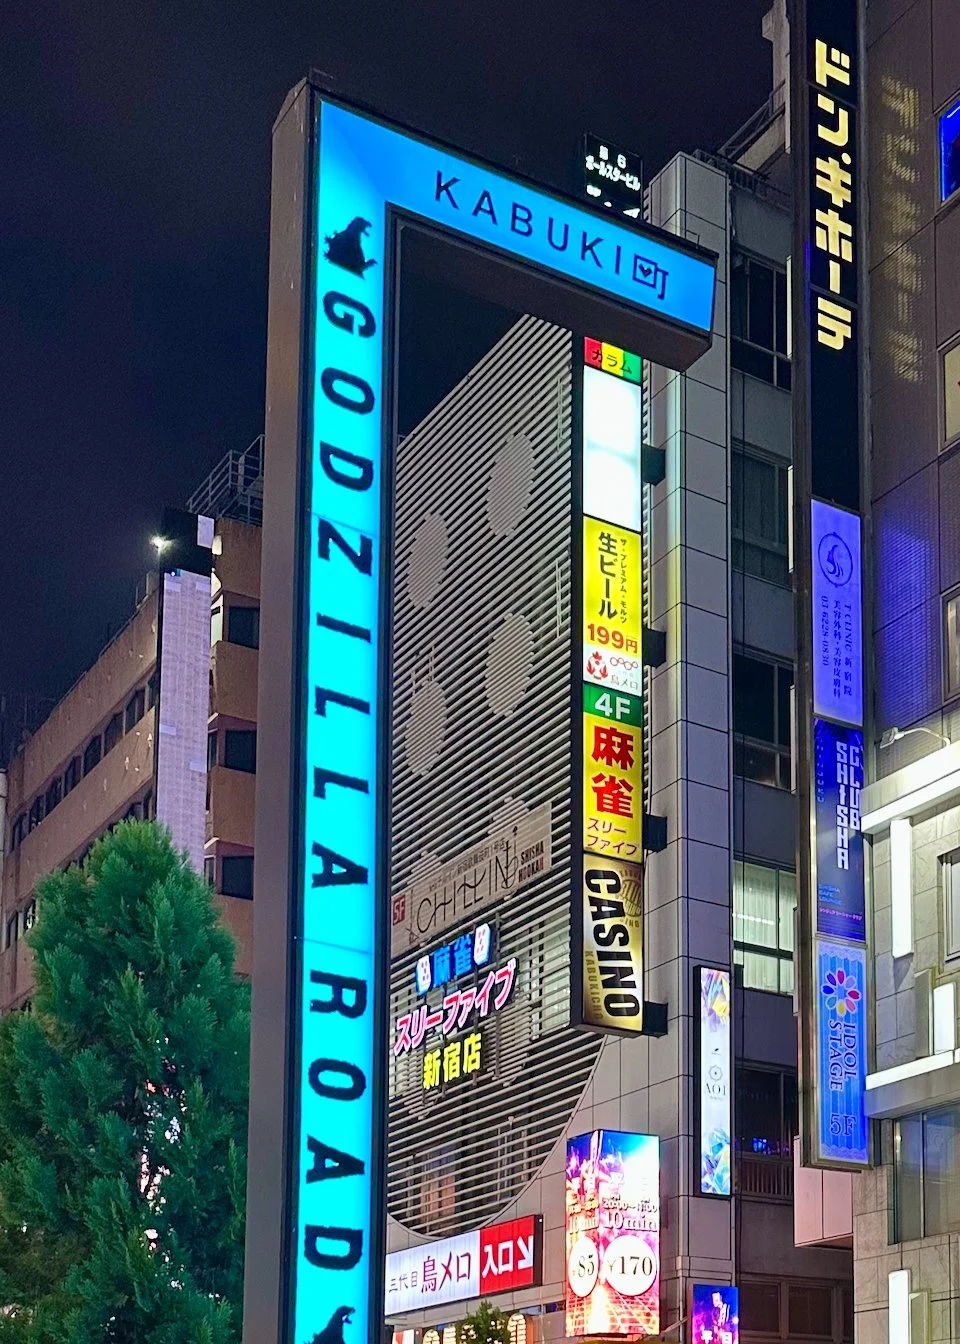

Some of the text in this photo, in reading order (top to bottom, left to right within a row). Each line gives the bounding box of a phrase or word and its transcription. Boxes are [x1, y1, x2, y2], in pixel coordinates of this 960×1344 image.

[598, 531, 618, 620] 生ビール
[587, 623, 638, 654] 199円
[594, 692, 631, 719] 4F
[303, 289, 377, 1271] GODZILLA ROAD
[591, 725, 634, 819] 麻雀
[850, 745, 860, 831] CLUB
[587, 817, 627, 835] スリー
[836, 741, 849, 870] SHISHA
[587, 834, 638, 856] ファイブ
[433, 933, 472, 988] 麻雀
[585, 868, 640, 1017] CASINO
[393, 957, 517, 1056] スリーファイブ
[423, 1032, 482, 1090] 新宿店
[829, 1020, 843, 1091] STAGE
[843, 1022, 857, 1079] IDOL
[830, 1114, 856, 1135] 5F
[389, 1250, 472, 1294] 三代目 鳥メロ
